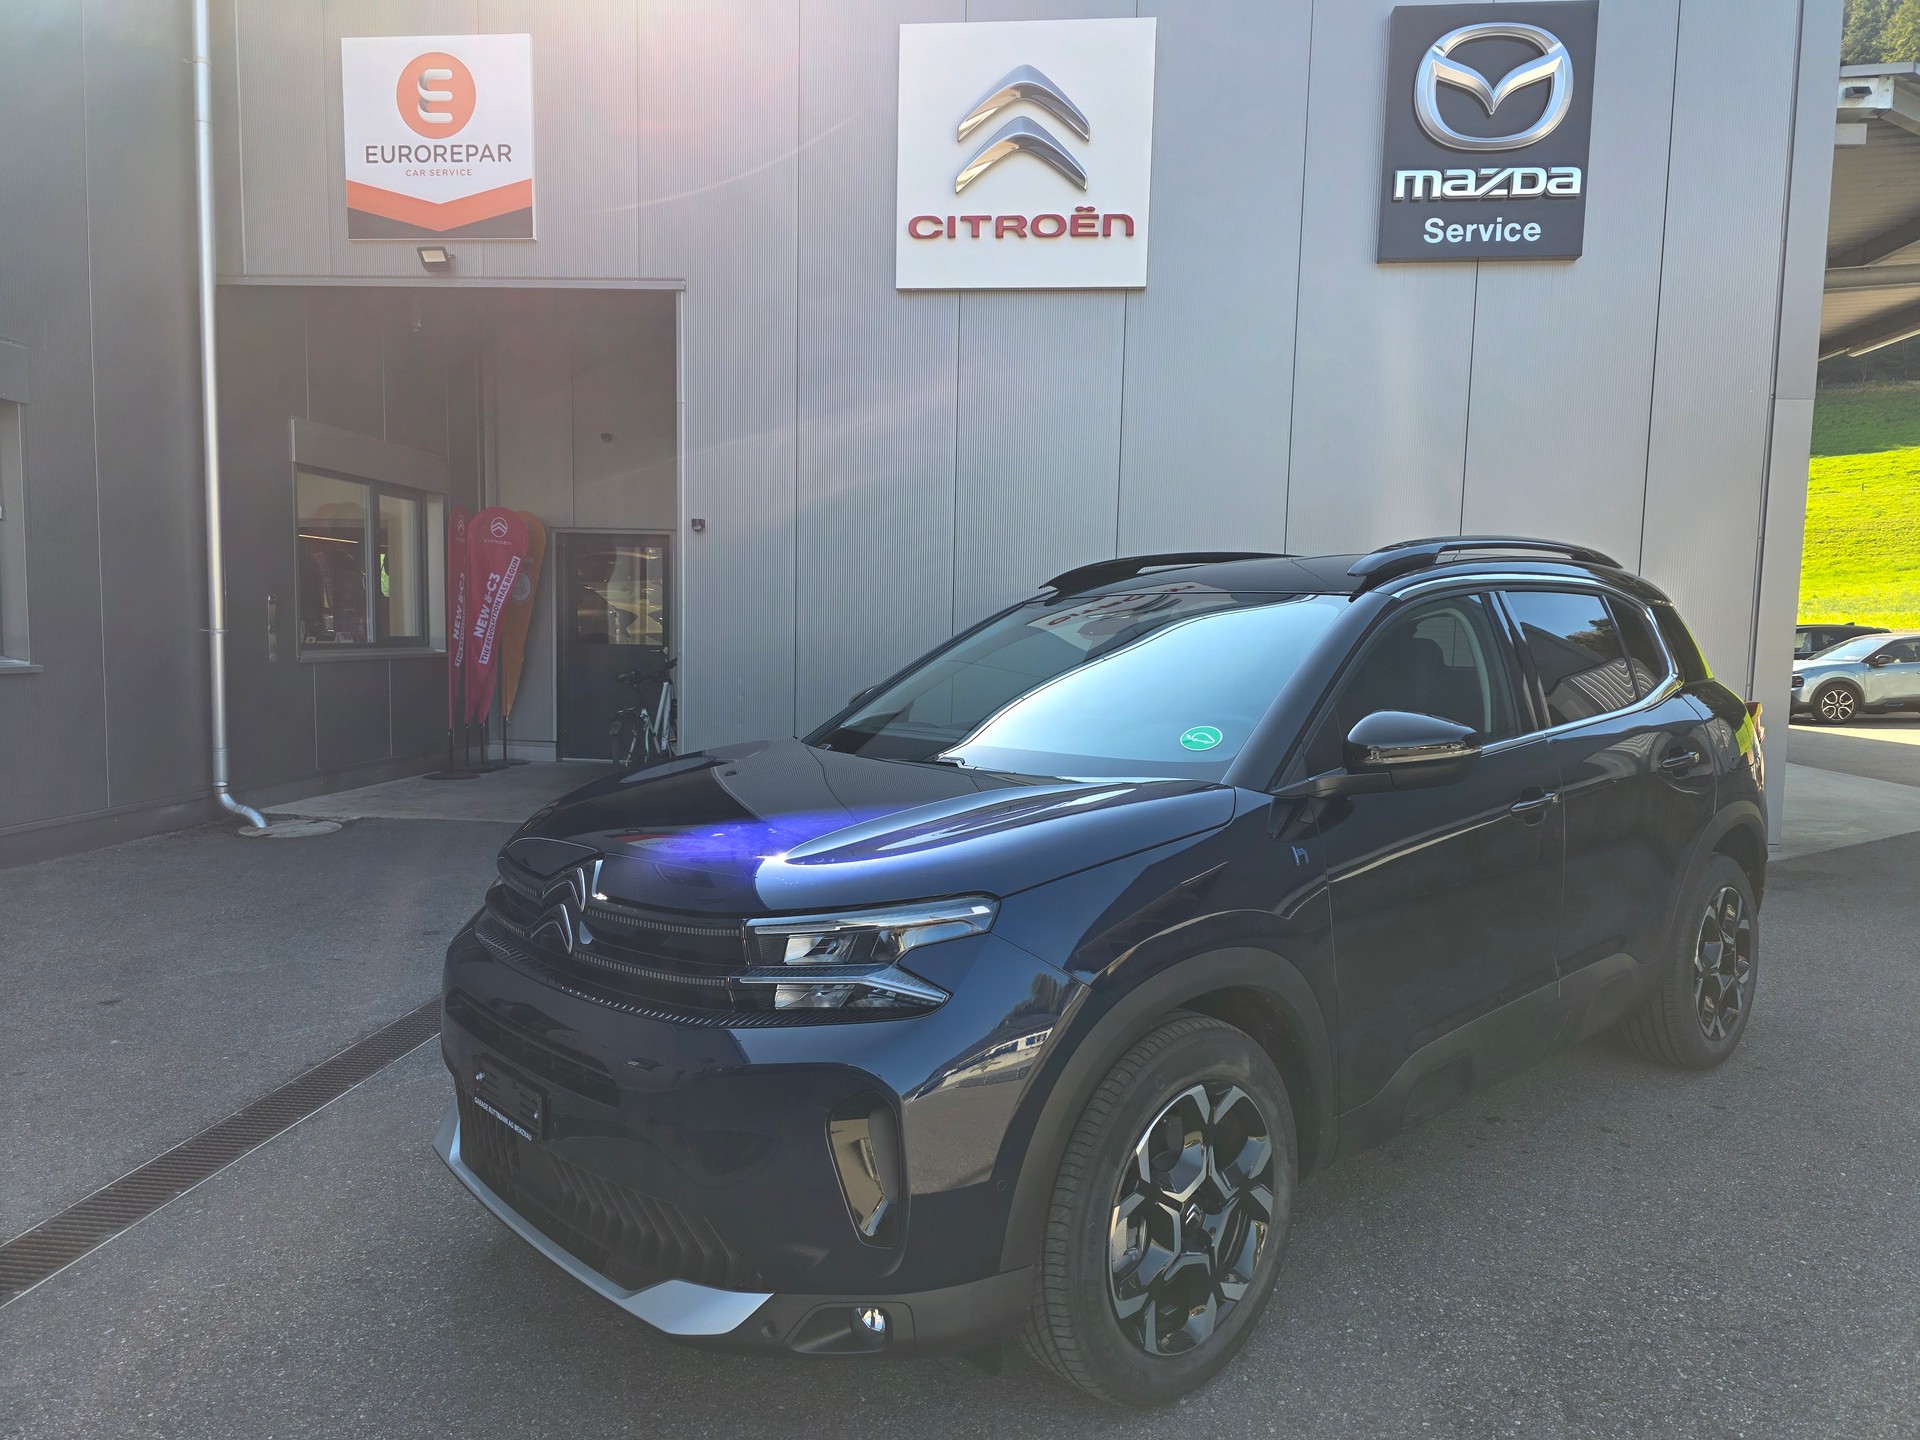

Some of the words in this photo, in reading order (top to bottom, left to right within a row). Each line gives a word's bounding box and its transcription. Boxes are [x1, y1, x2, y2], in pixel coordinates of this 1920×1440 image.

[365, 143, 512, 164] EUROREPAR
[405, 169, 426, 177] CAR
[429, 168, 472, 177] SERVICE
[1423, 217, 1542, 244] Service
[452, 604, 462, 640] NEW
[473, 604, 490, 638] NEW
[481, 647, 490, 662] THE
[486, 599, 501, 647] REVOLUTION
[497, 583, 509, 600] HAS
[505, 557, 519, 583] BEGUN
